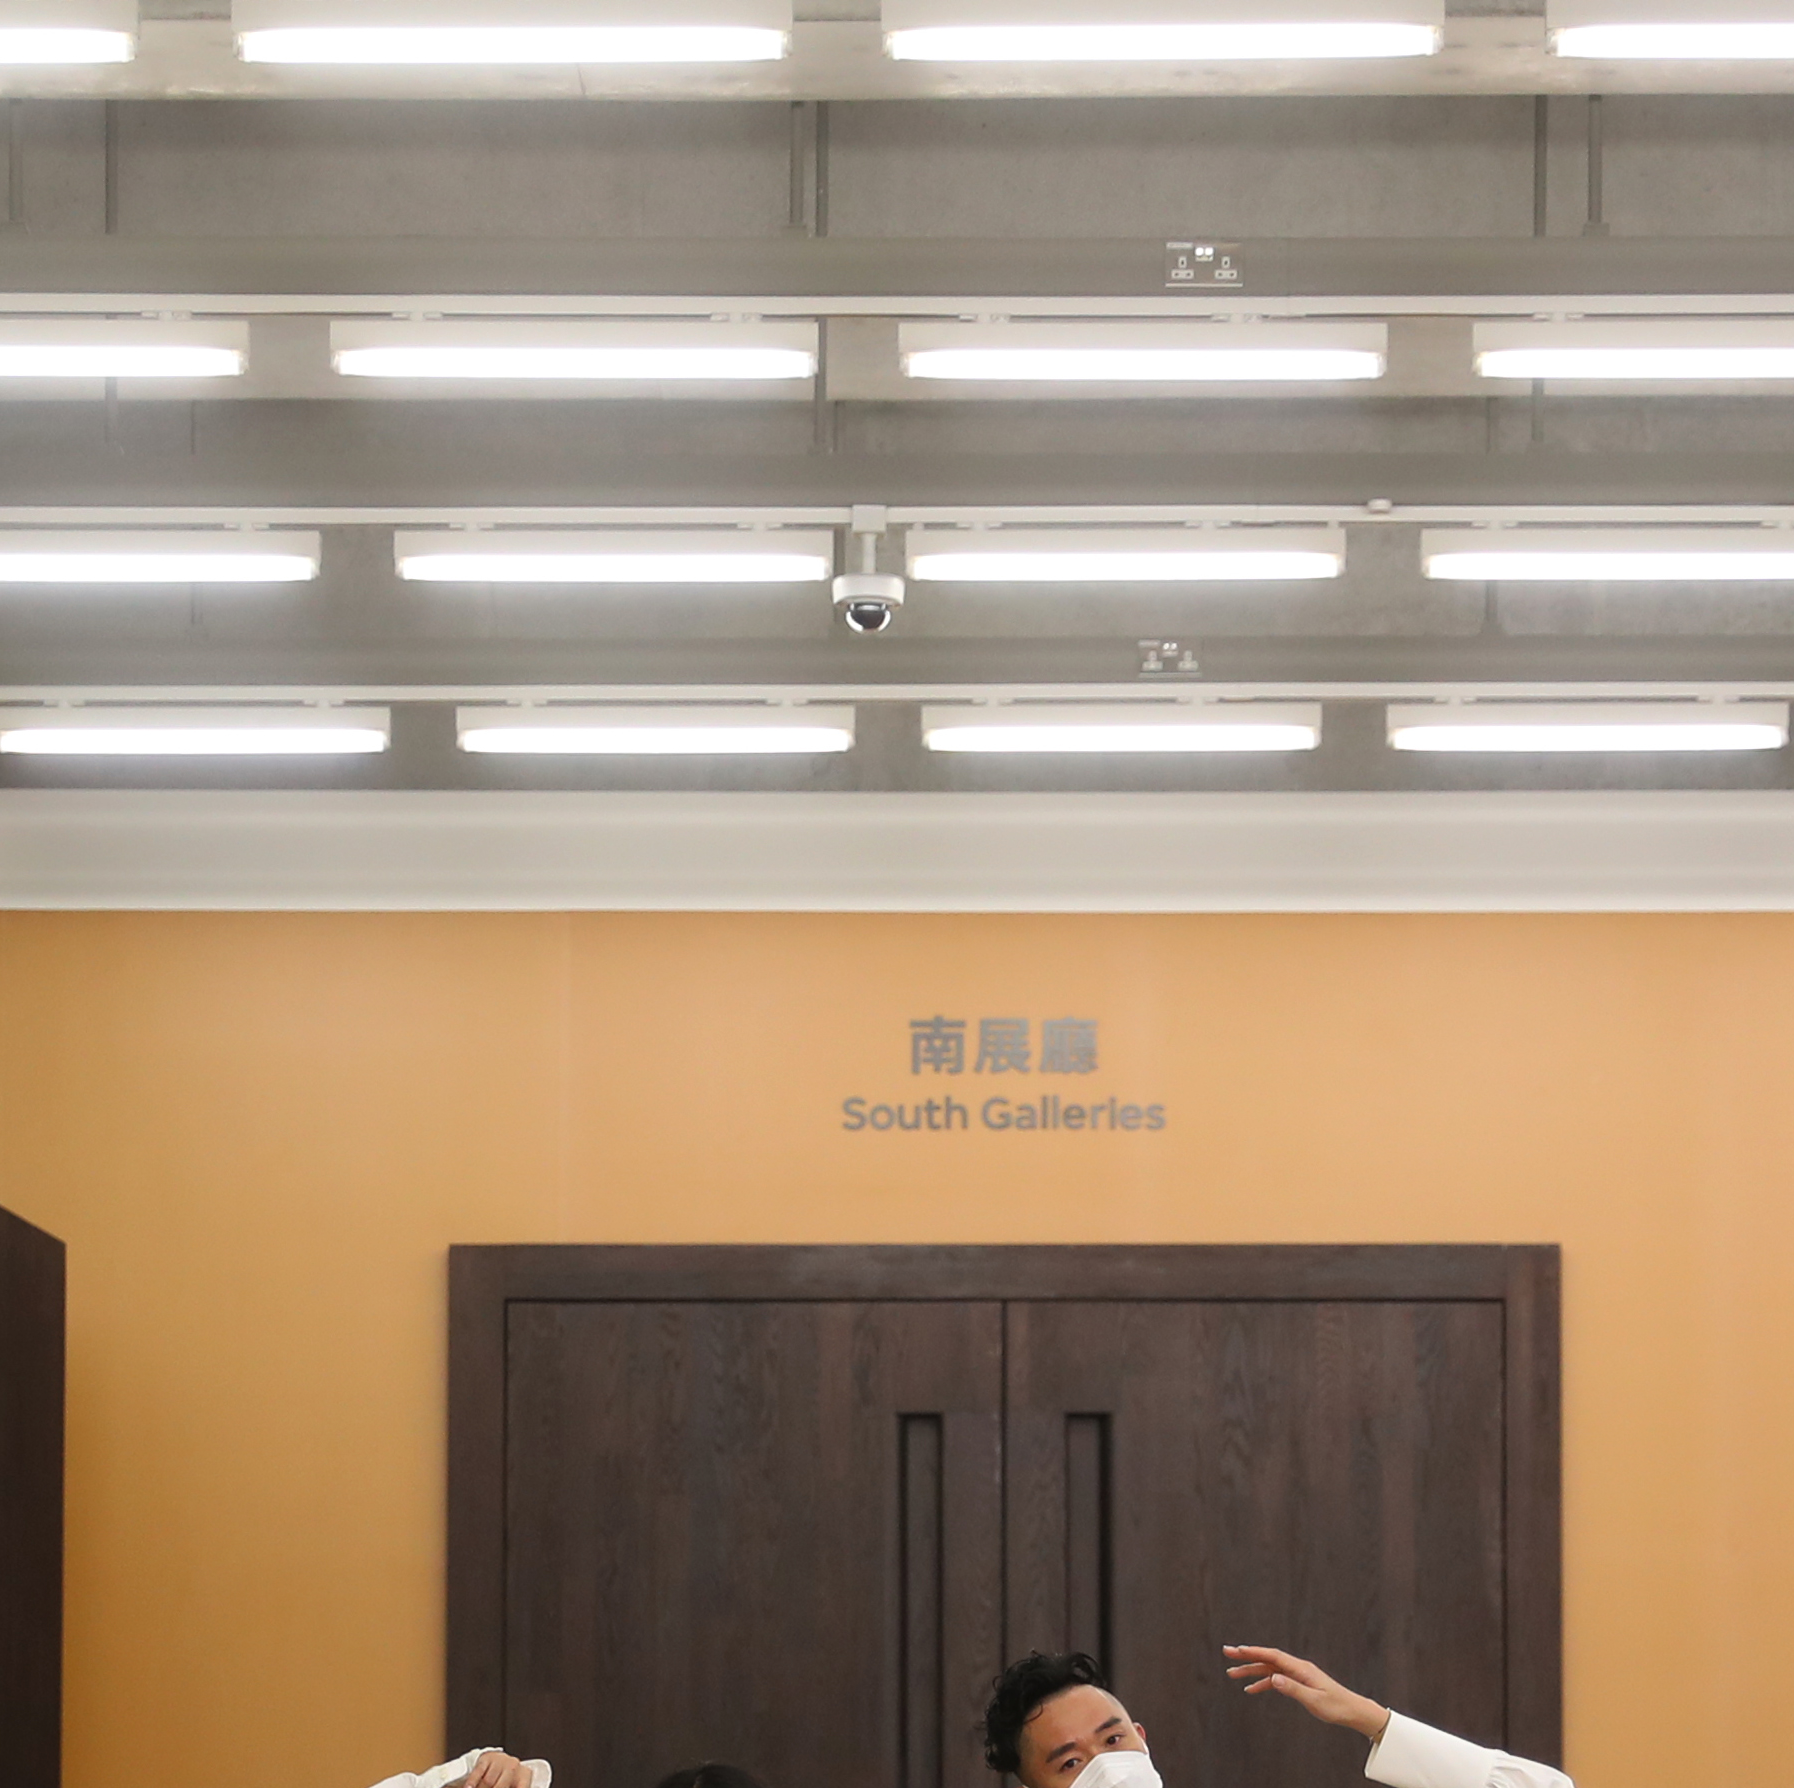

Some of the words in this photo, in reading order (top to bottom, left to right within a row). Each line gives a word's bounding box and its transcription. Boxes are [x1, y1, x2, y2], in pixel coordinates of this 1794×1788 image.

[910, 1015, 1099, 1075] 南展廳
[842, 1097, 969, 1131] South
[981, 1096, 1166, 1131] Galleries
